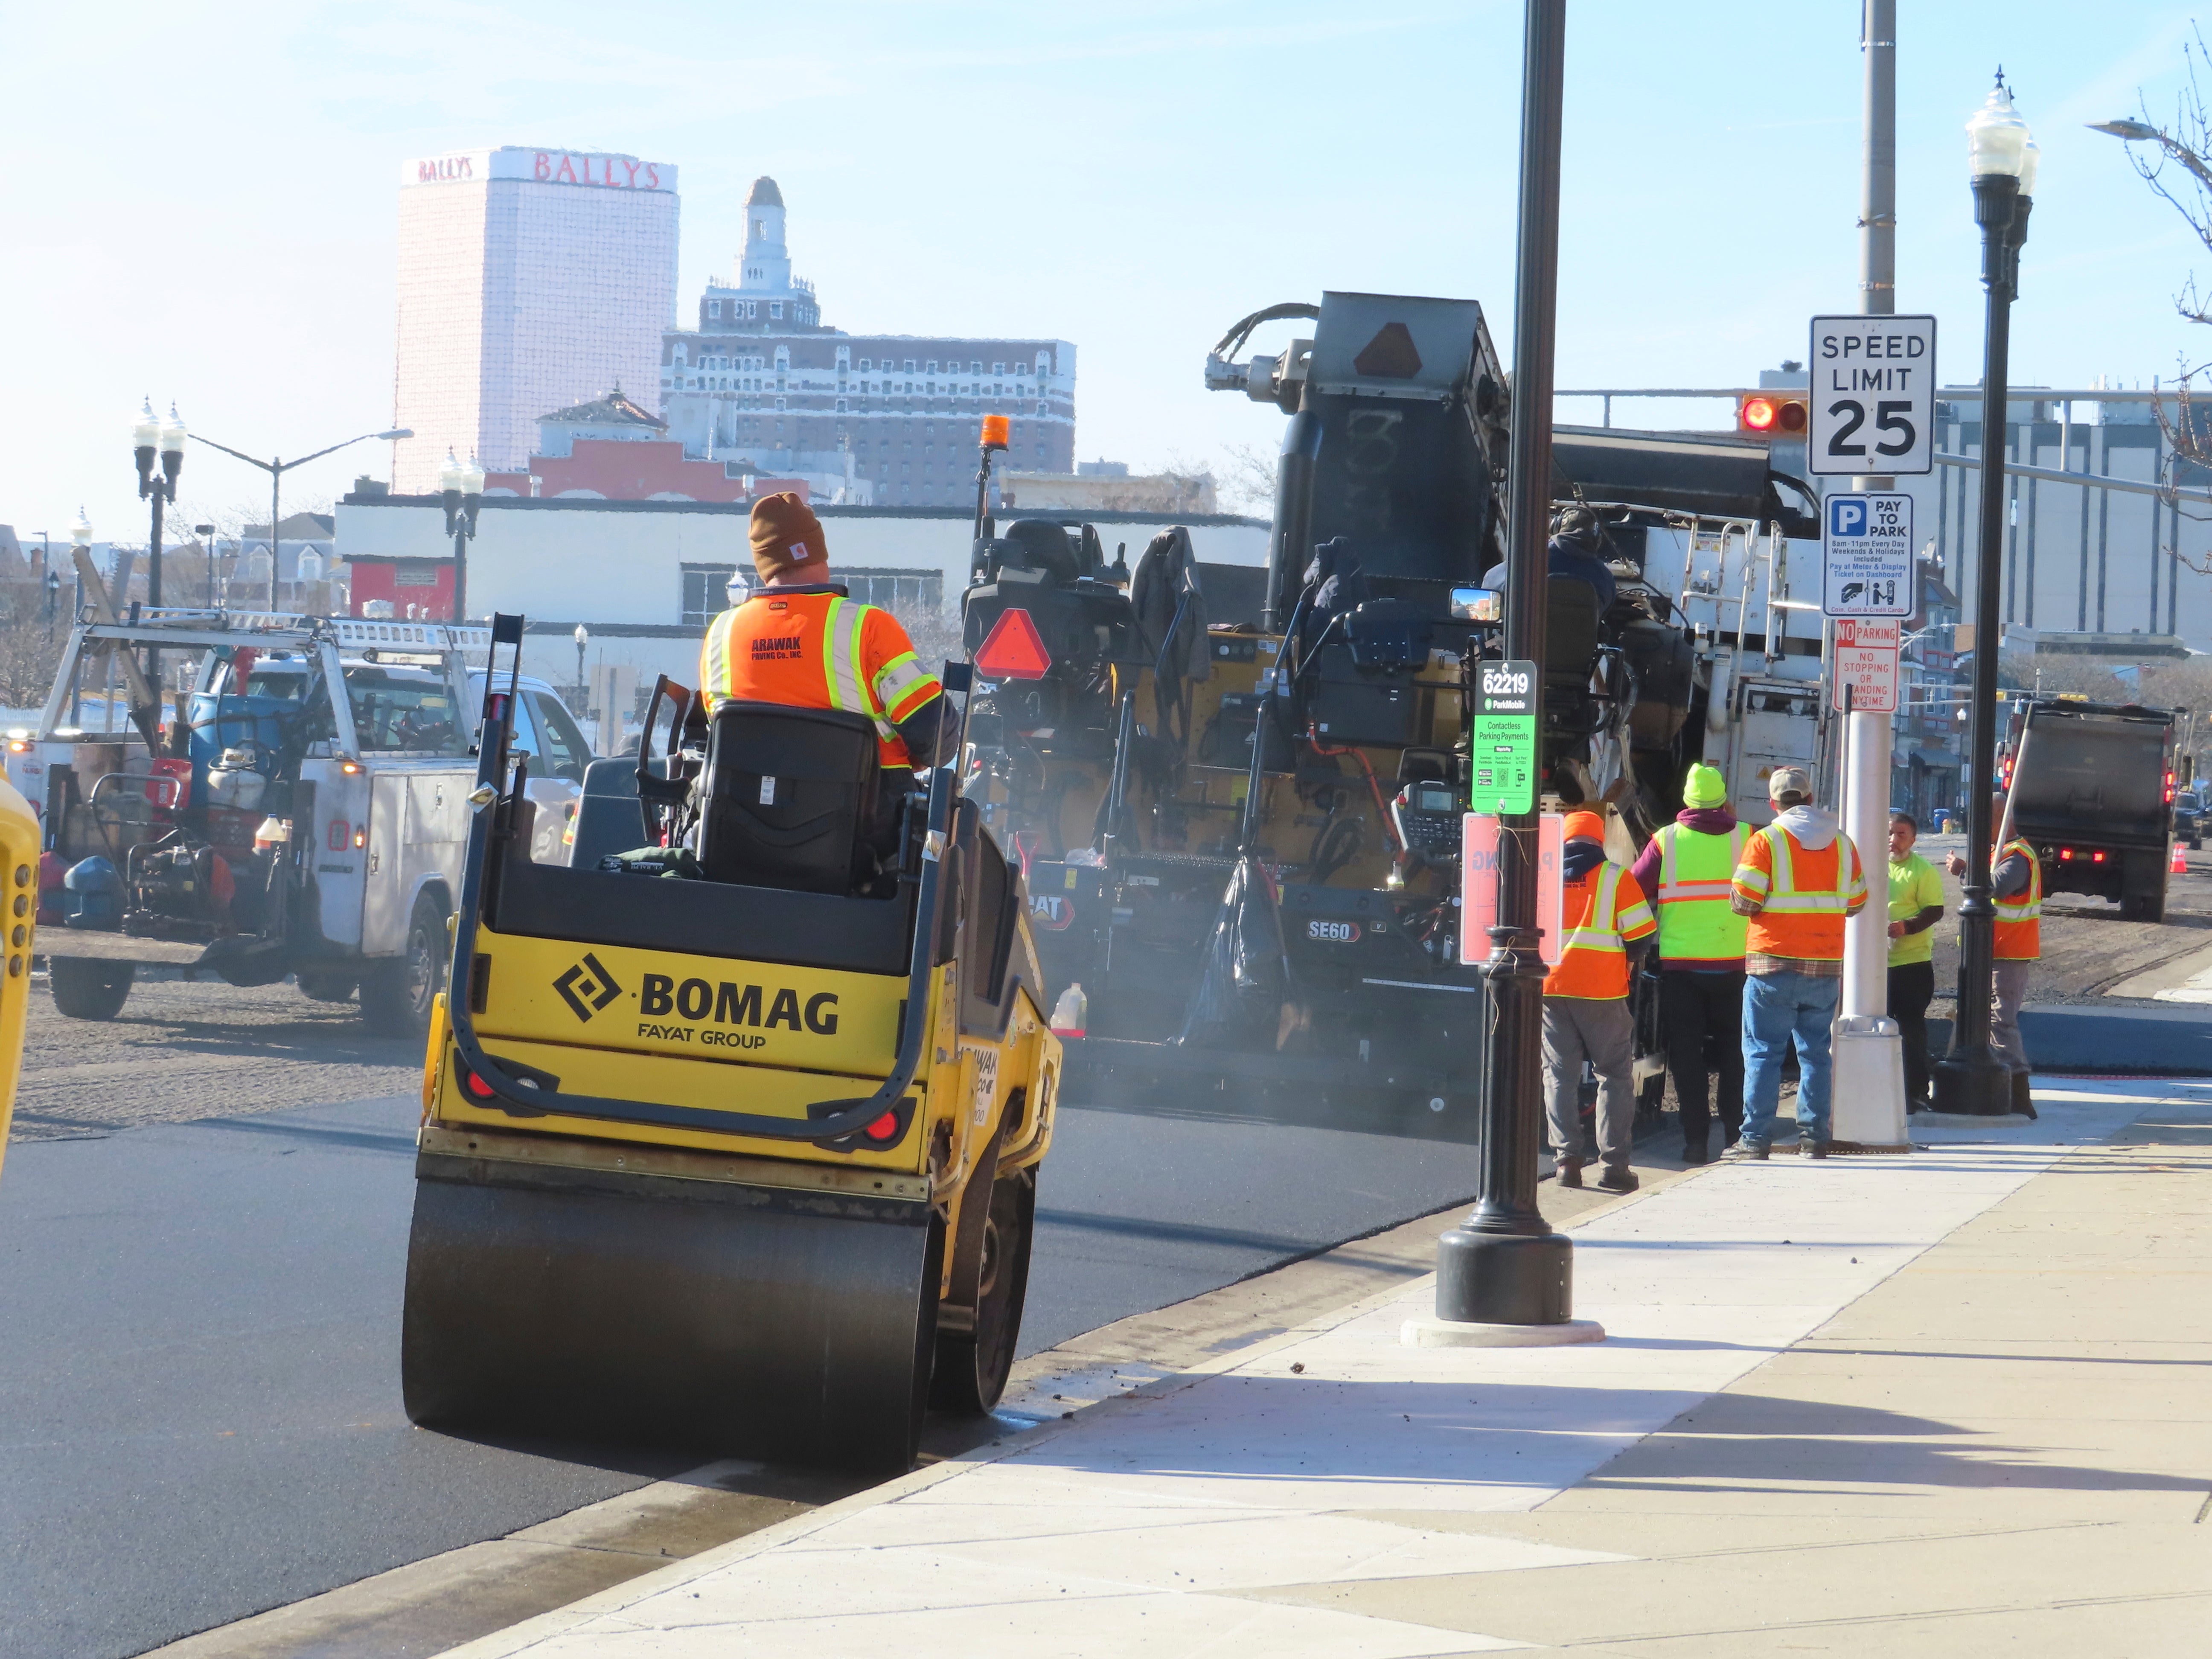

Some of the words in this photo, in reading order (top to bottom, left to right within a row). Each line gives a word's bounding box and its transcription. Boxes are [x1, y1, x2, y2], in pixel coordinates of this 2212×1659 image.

[1822, 335, 1924, 358] SPEED
[1833, 368, 1912, 391] LIMIT
[1828, 399, 1916, 456] 25
[1876, 501, 1902, 512] PAY
[1839, 505, 1862, 533] P
[1879, 513, 1898, 524] TO
[1870, 526, 1907, 537] PARK
[1892, 540, 1905, 548] Day
[1837, 623, 1854, 641] NO
[1857, 627, 1895, 640] PARKING
[751, 636, 800, 652] ARAWAK
[751, 652, 775, 661] PAVING
[789, 650, 803, 658] INC.
[1859, 652, 1874, 661] NO
[1844, 663, 1889, 673] STOPPING
[1483, 672, 1528, 694] 62219
[1860, 674, 1872, 683] OR
[1852, 684, 1887, 695] ANDING
[1493, 700, 1525, 709] ParkMobile
[1852, 696, 1884, 706] NYTIME
[1487, 721, 1521, 730] Contactless
[1479, 732, 1500, 742] Parking
[1501, 732, 1529, 742] Payments
[1308, 920, 1350, 940] SE60
[640, 973, 838, 1035] BOMAG
[637, 1023, 695, 1042] FAYAT
[700, 1030, 766, 1050] GROUP
